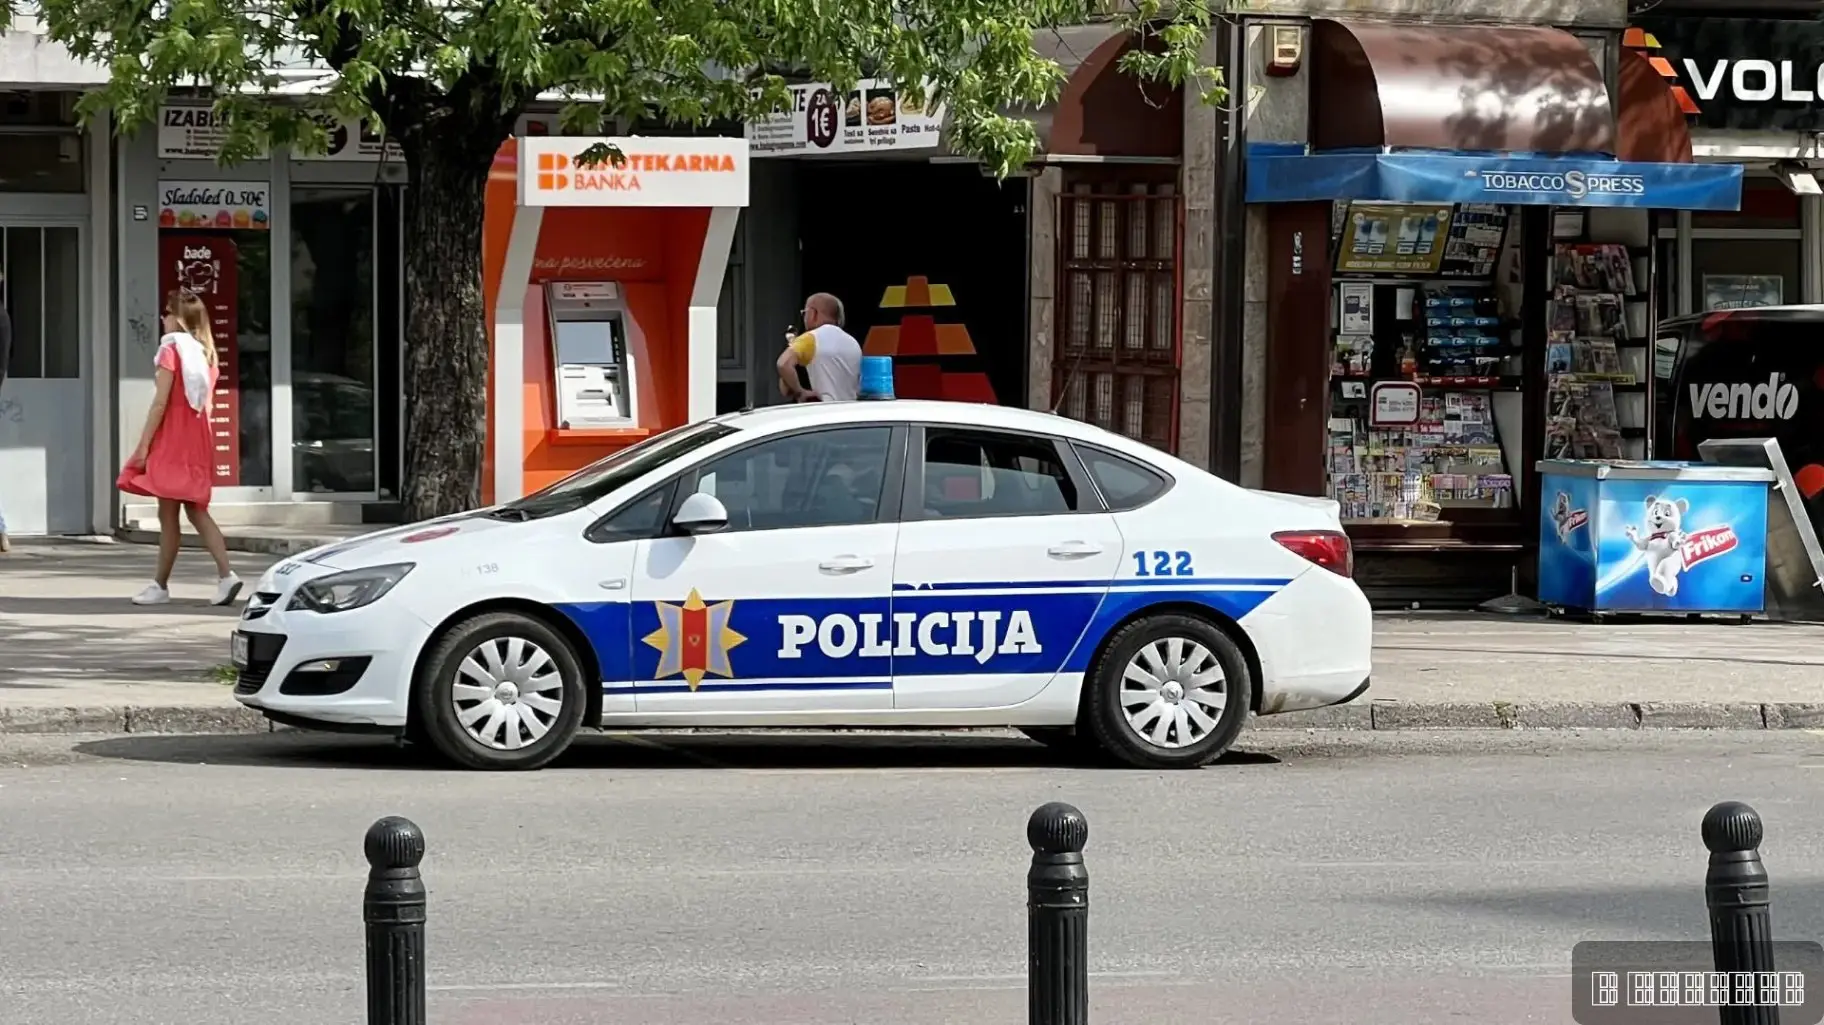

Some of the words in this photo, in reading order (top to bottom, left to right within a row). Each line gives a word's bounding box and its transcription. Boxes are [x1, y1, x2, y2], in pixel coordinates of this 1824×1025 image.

[1683, 58, 1824, 101] VOL
[812, 107, 831, 137] 1€
[573, 153, 735, 172] TEKARNA
[575, 174, 641, 190] BANKA
[1482, 174, 1564, 190] TOBACCO
[1565, 170, 1587, 198] S
[1588, 177, 1644, 193] PRESS
[162, 187, 224, 206] Sladoled
[225, 189, 265, 207] 0.50€
[1689, 372, 1799, 420] vendo
[1132, 550, 1194, 576] 122
[778, 610, 1042, 665] POLICIJA
